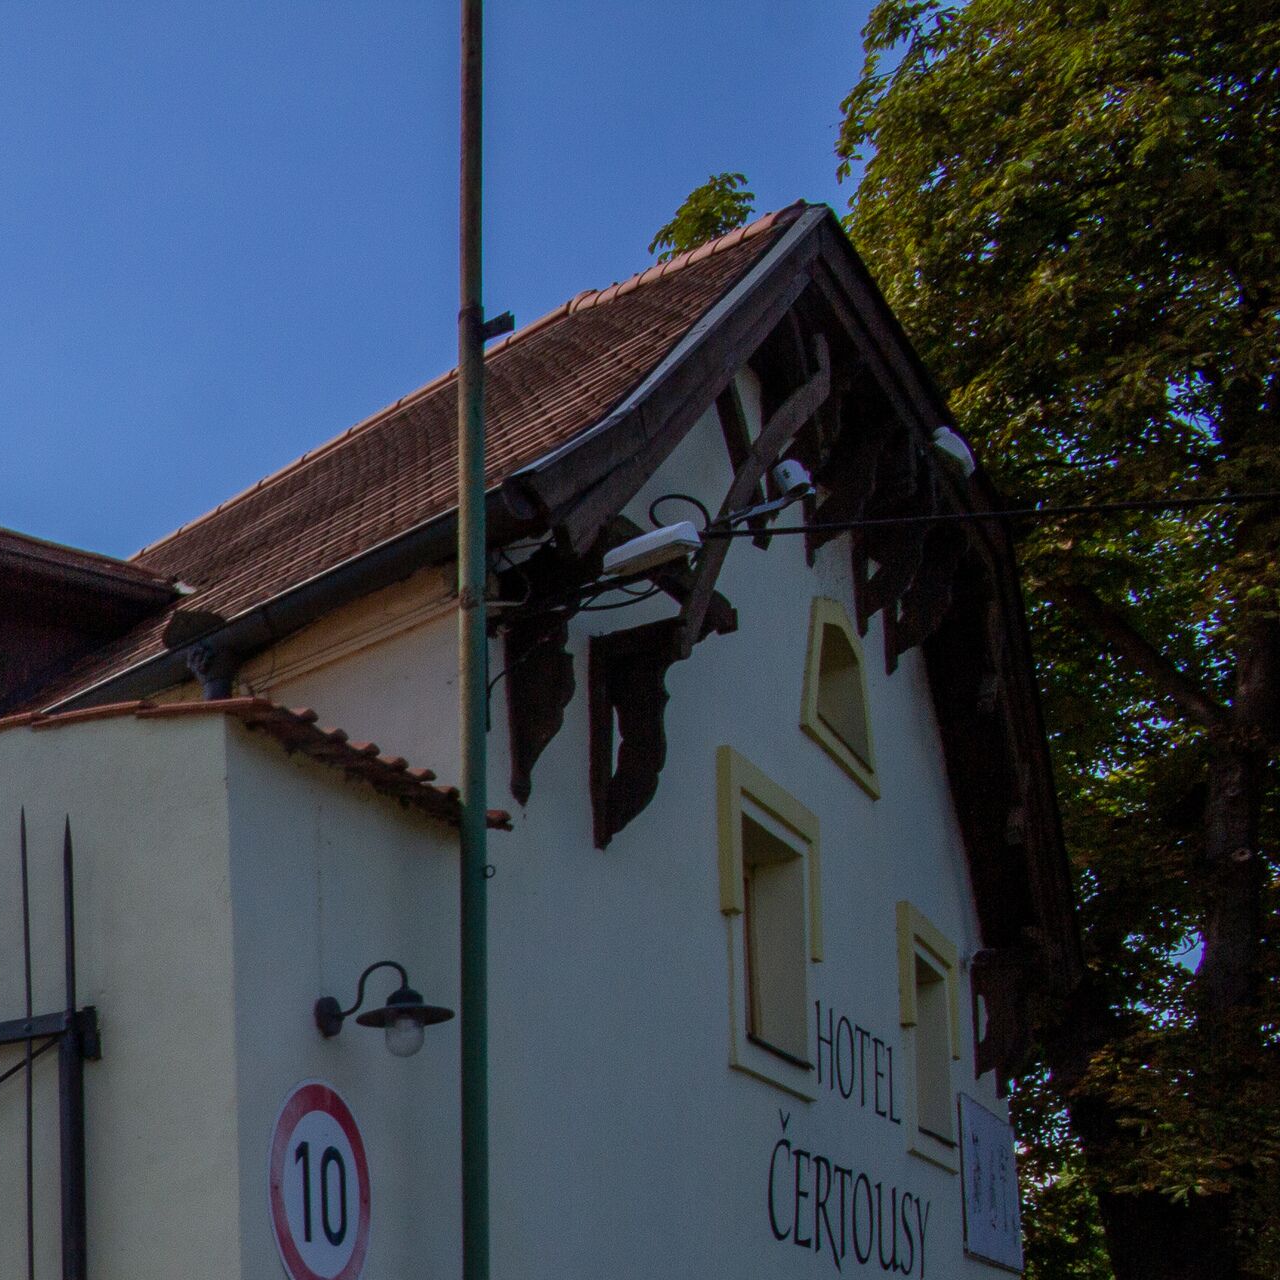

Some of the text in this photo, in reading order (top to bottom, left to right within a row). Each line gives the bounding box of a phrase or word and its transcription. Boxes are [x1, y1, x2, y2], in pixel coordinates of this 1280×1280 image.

[815, 1000, 901, 1125] HOTEL
[295, 1141, 347, 1247] 10
[767, 1108, 930, 1280] ČERTOUSY
